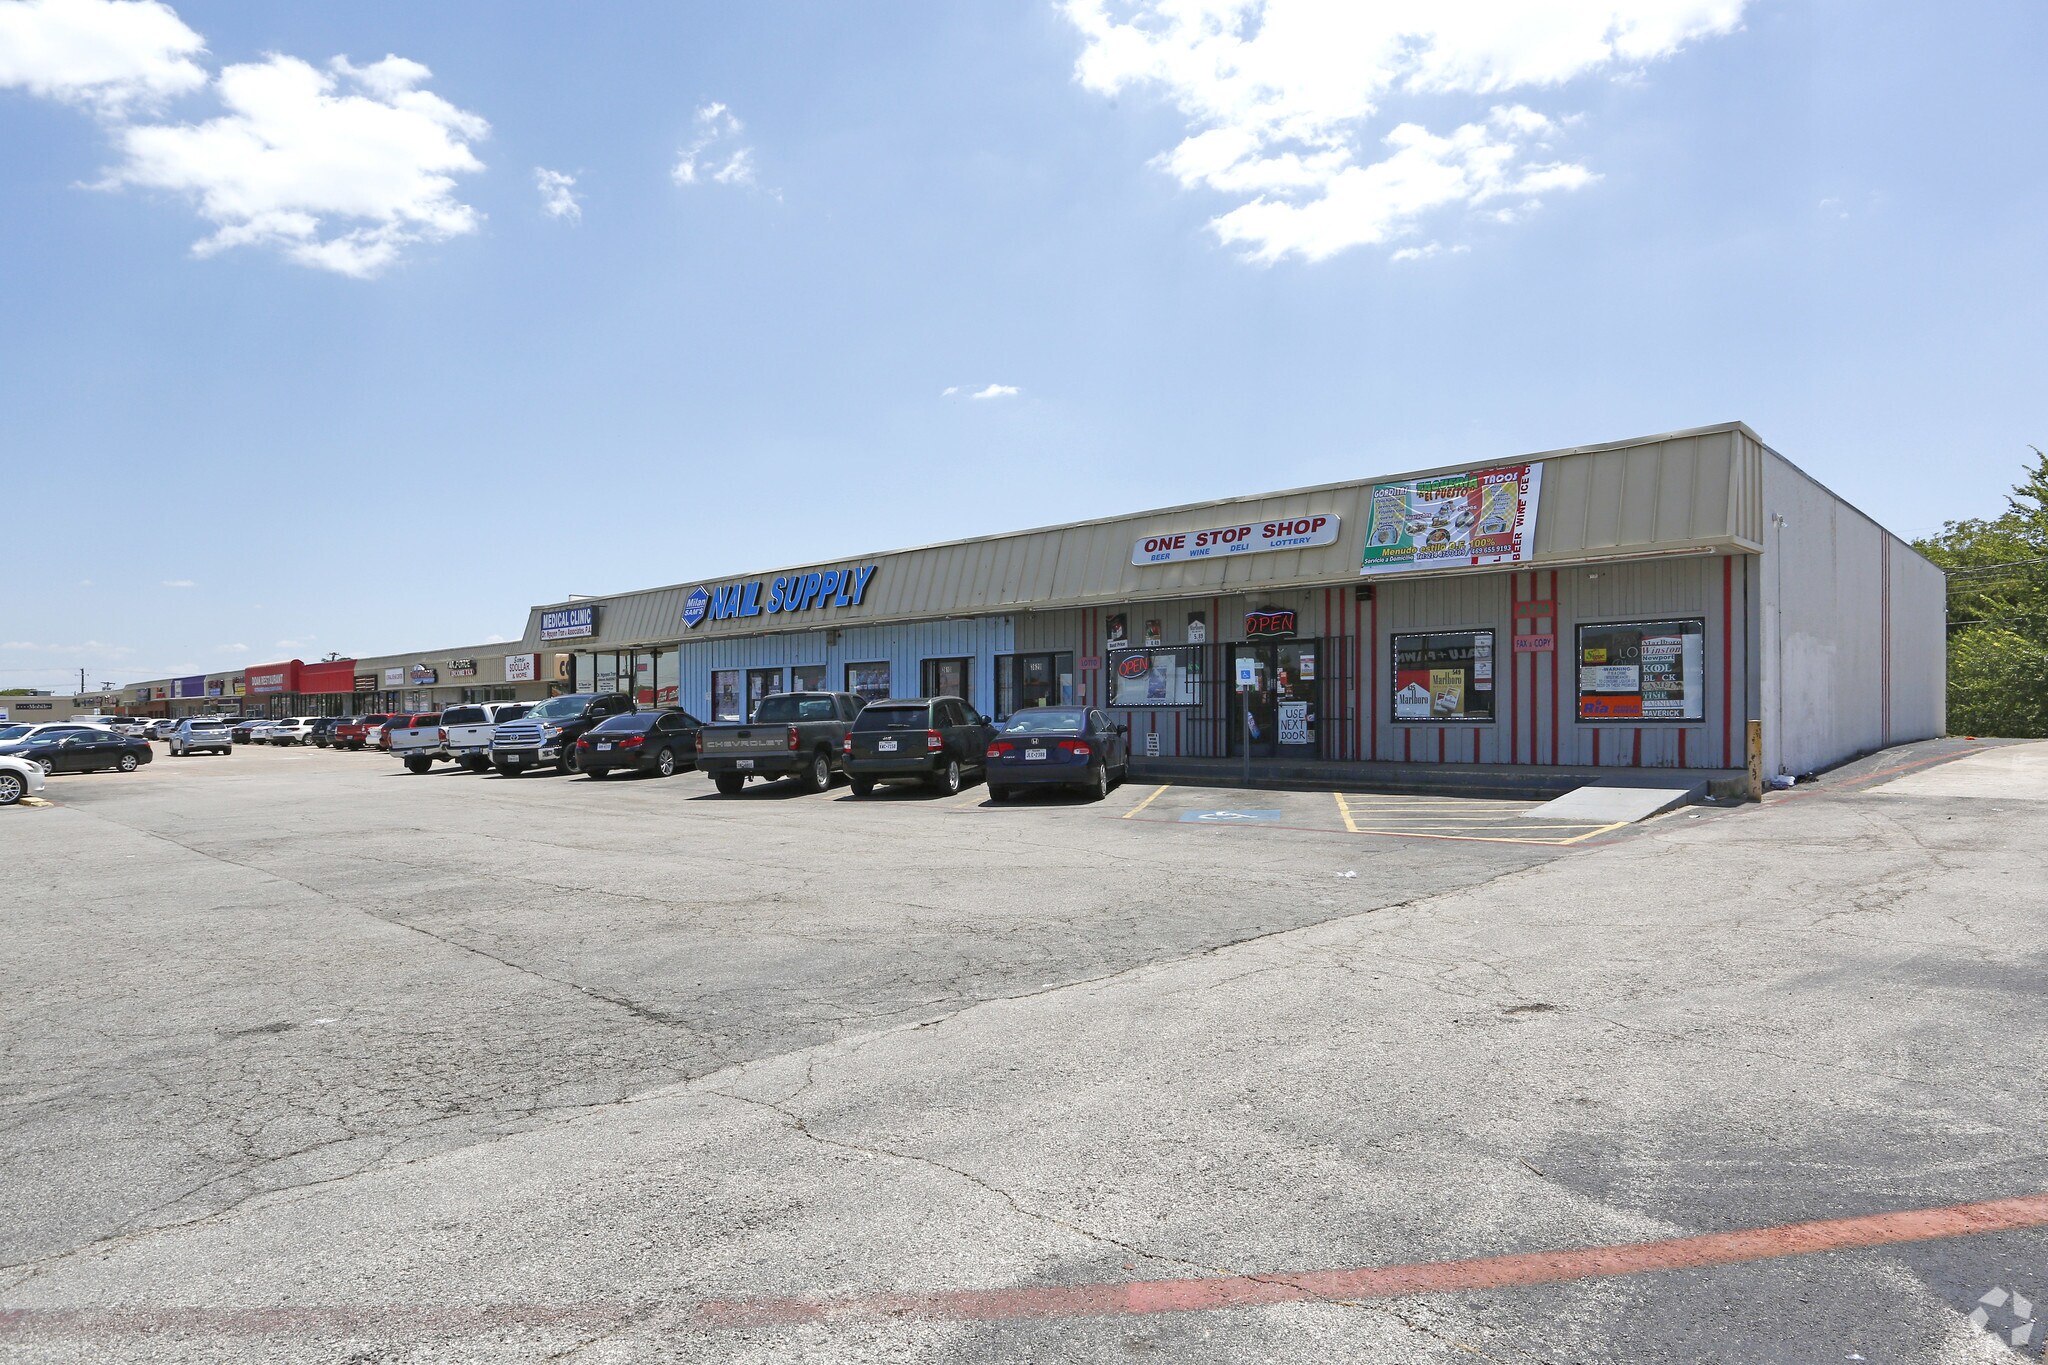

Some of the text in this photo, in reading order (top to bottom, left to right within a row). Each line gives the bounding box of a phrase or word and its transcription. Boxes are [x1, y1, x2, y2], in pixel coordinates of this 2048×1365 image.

[1483, 472, 1518, 484] TACOS
[1516, 499, 1526, 527] WINE
[1144, 517, 1326, 552] ONE STOP SHOP
[1151, 537, 1311, 561] BEER WINE DELI LOTTERY
[1382, 546, 1418, 557] Menudo
[1420, 544, 1446, 553] estilo
[1470, 538, 1495, 547] 100%
[1484, 546, 1495, 554] 655
[1512, 532, 1522, 560] BEER
[708, 565, 876, 620] NAIL SUPPLY
[1520, 604, 1550, 615] ATM
[543, 608, 591, 628] MEDICAL CLINIC
[1247, 614, 1294, 633] OPEN
[1534, 638, 1552, 647] COPY
[1081, 659, 1098, 667] LOTTO
[1119, 658, 1148, 677] OPEN
[1643, 664, 1672, 673] KOOL
[1433, 672, 1461, 685] Marlboro
[1399, 687, 1429, 704] Marlboro
[1584, 699, 1609, 713] Ria
[1286, 709, 1304, 718] USE
[1281, 720, 1304, 730] NEXT
[1281, 730, 1305, 740] DOOR
[707, 740, 783, 748] CHEVROLET
